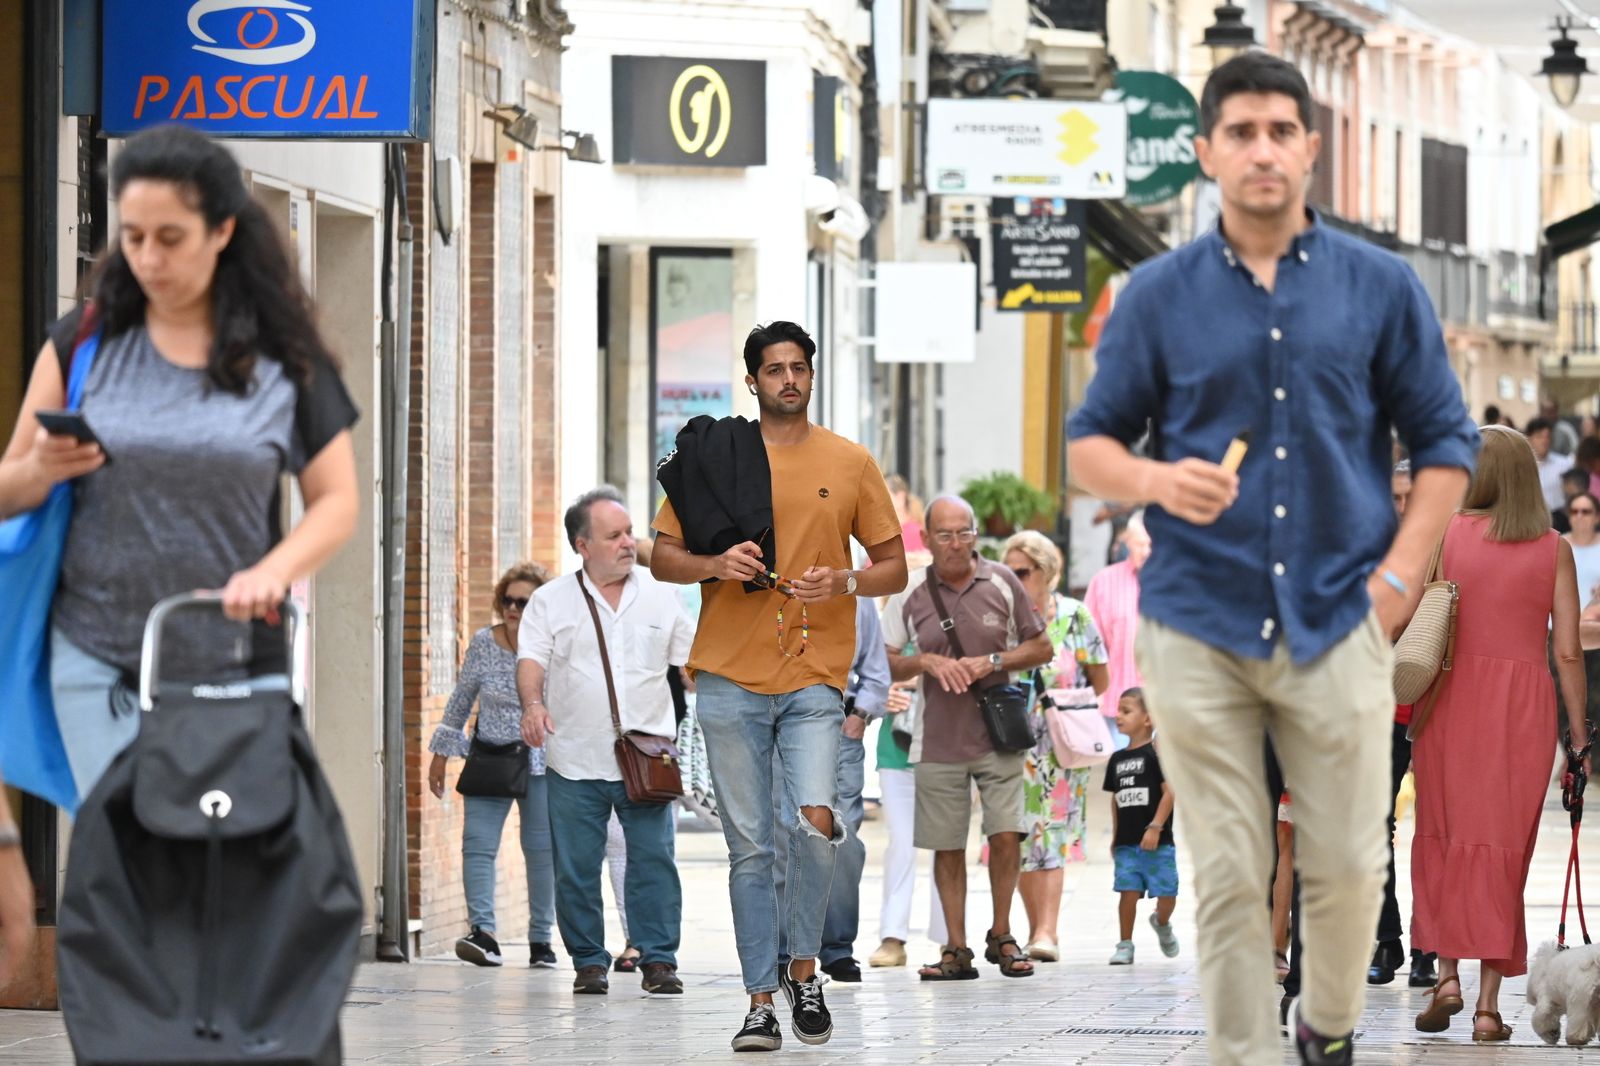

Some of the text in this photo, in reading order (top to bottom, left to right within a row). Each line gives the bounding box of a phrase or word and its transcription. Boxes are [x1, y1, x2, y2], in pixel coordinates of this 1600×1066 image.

[132, 75, 379, 119] PASCUAL
[953, 123, 1042, 134] ATRESMEDIA
[1005, 136, 1043, 146] RADIO
[1116, 760, 1144, 774] ENJOY
[1119, 775, 1135, 787] THE
[1116, 792, 1144, 804] USIC
